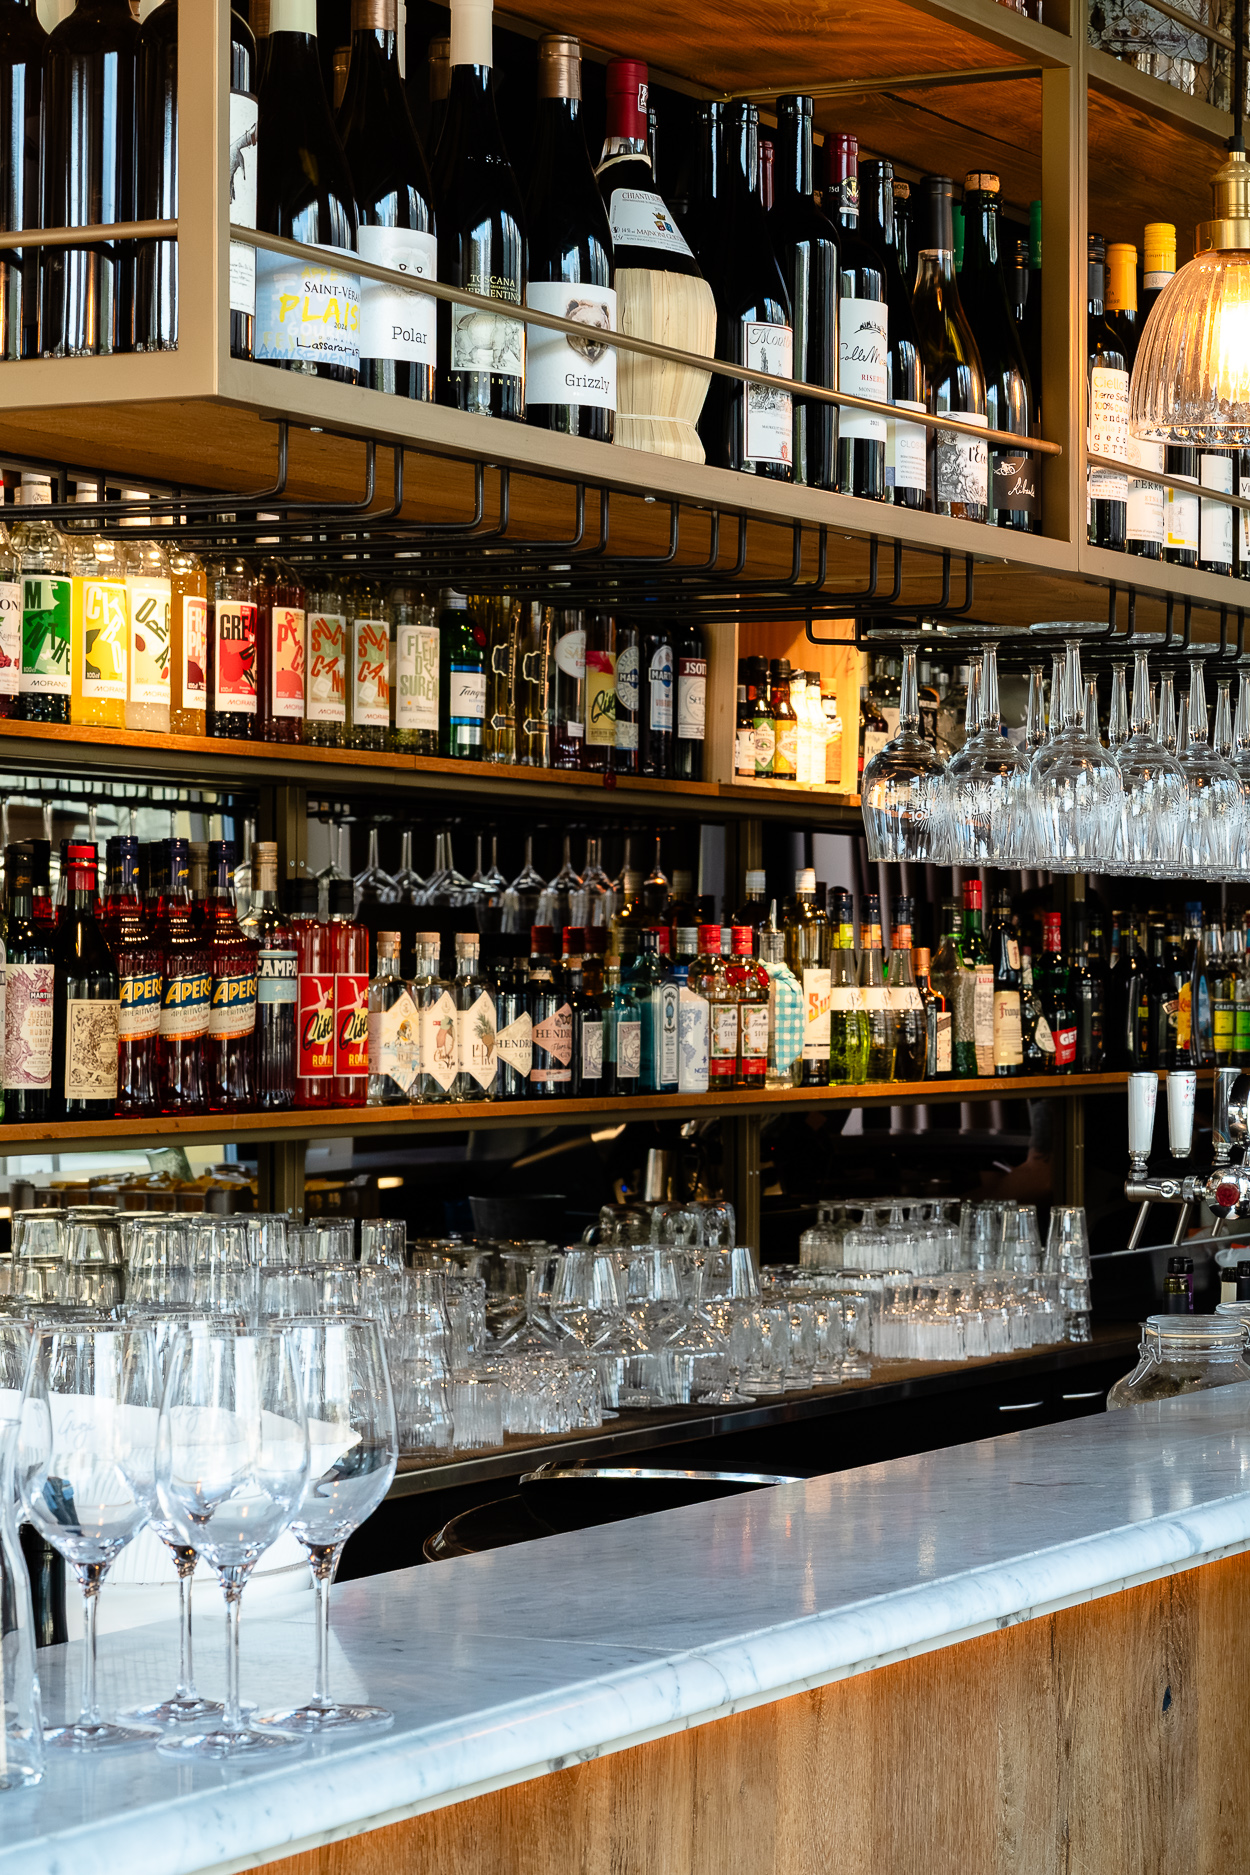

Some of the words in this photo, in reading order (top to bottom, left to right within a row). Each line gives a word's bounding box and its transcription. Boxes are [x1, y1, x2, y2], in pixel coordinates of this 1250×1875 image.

[470, 274, 516, 288] TOSCANA
[391, 325, 428, 346] Polar
[565, 373, 611, 395] Grizzly
